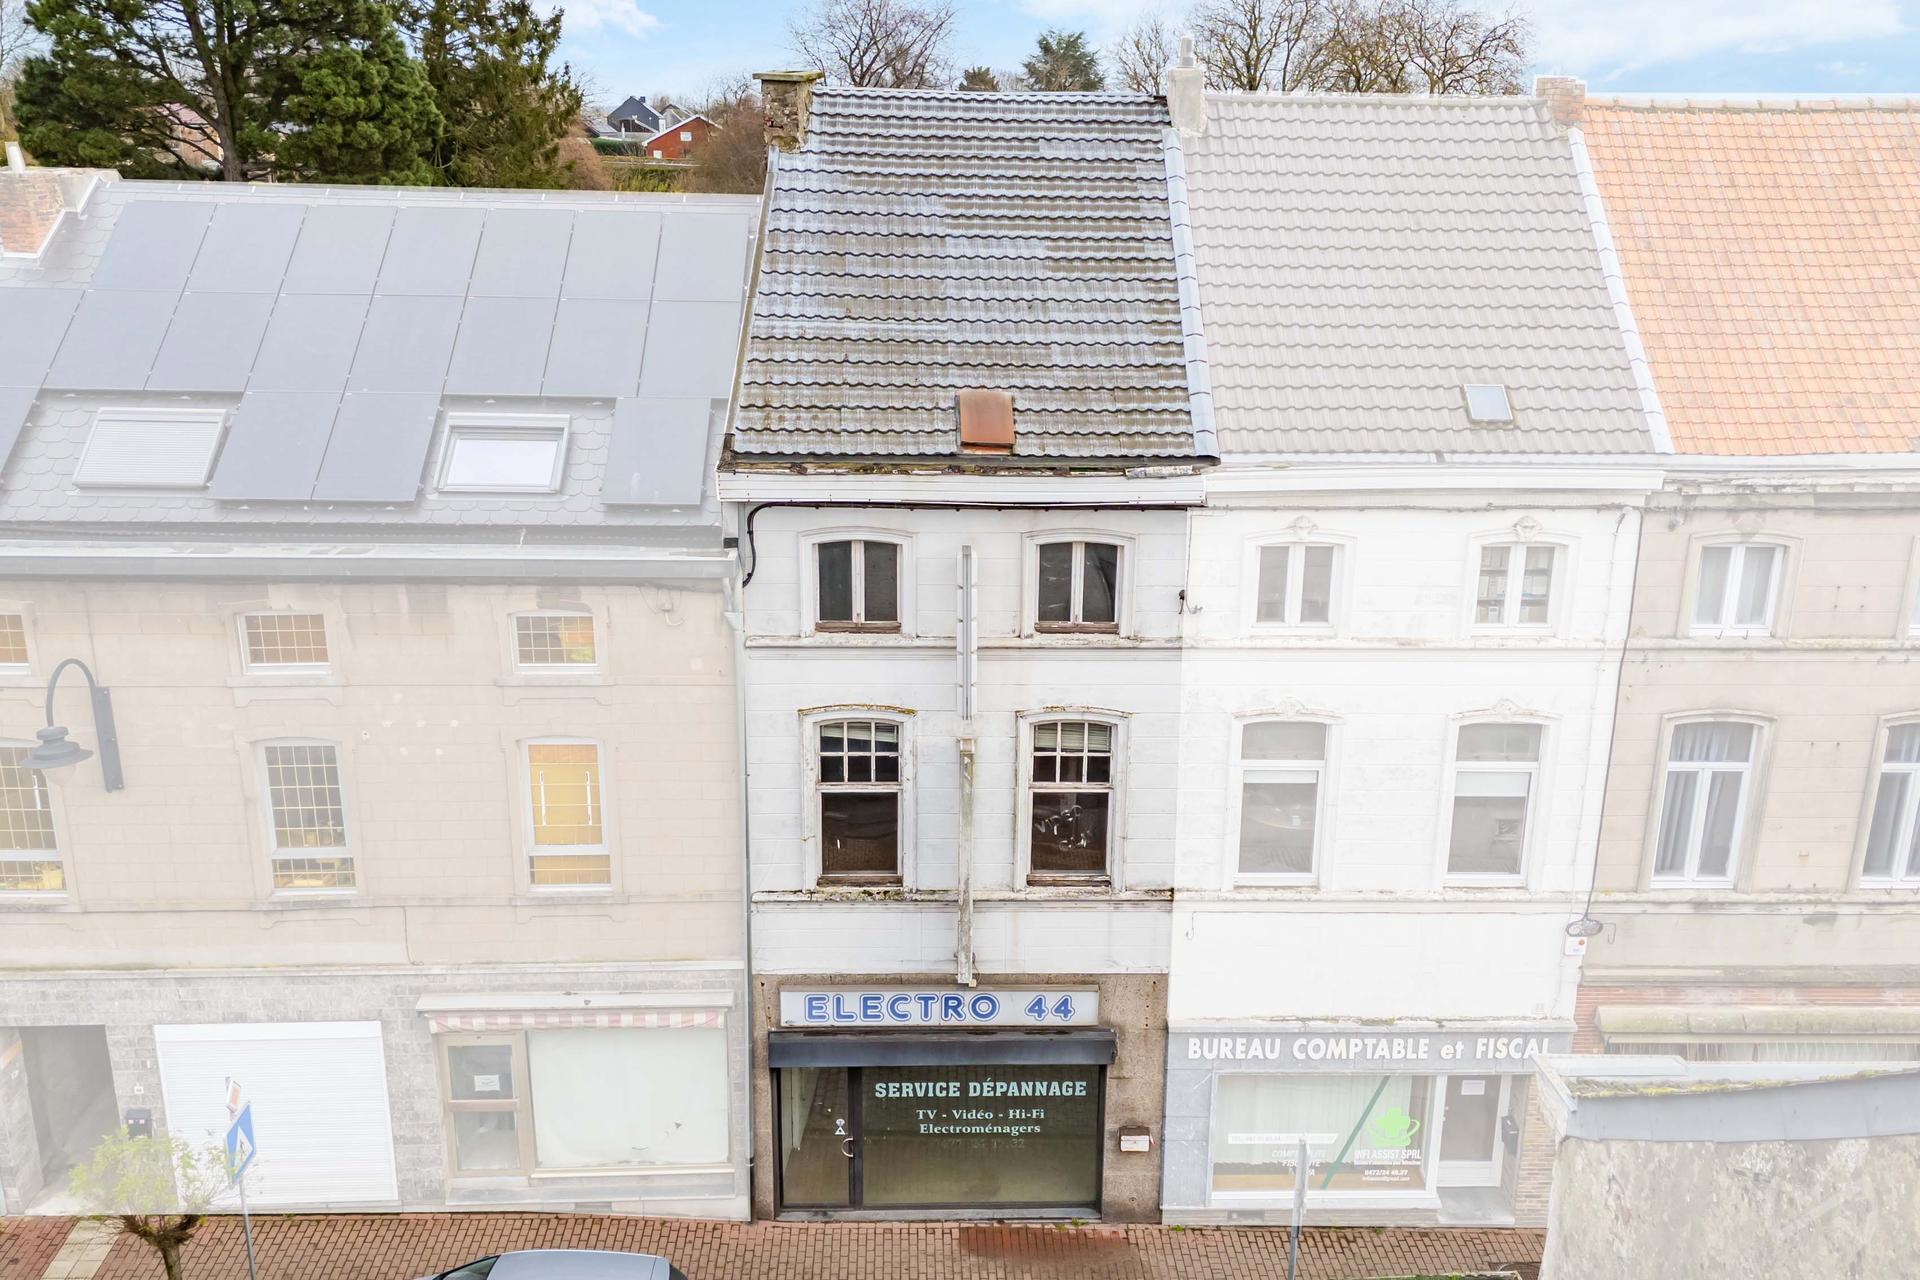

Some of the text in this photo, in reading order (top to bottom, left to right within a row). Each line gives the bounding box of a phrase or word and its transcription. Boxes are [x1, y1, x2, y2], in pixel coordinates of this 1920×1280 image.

[804, 993, 1076, 1022] ELECTRO 44
[1188, 1037, 1281, 1060] BUREAU
[1292, 1037, 1430, 1060] COMPTABLE
[1440, 1041, 1465, 1060] et
[875, 1077, 1087, 1098] SERVICE DÉPANNAGE
[916, 1109, 938, 1120] TV
[951, 1108, 994, 1120] Vidéo
[1007, 1108, 1045, 1120] Hi-Fi
[919, 1123, 1041, 1137] Electroménagers
[1401, 1149, 1422, 1159] SPRL
